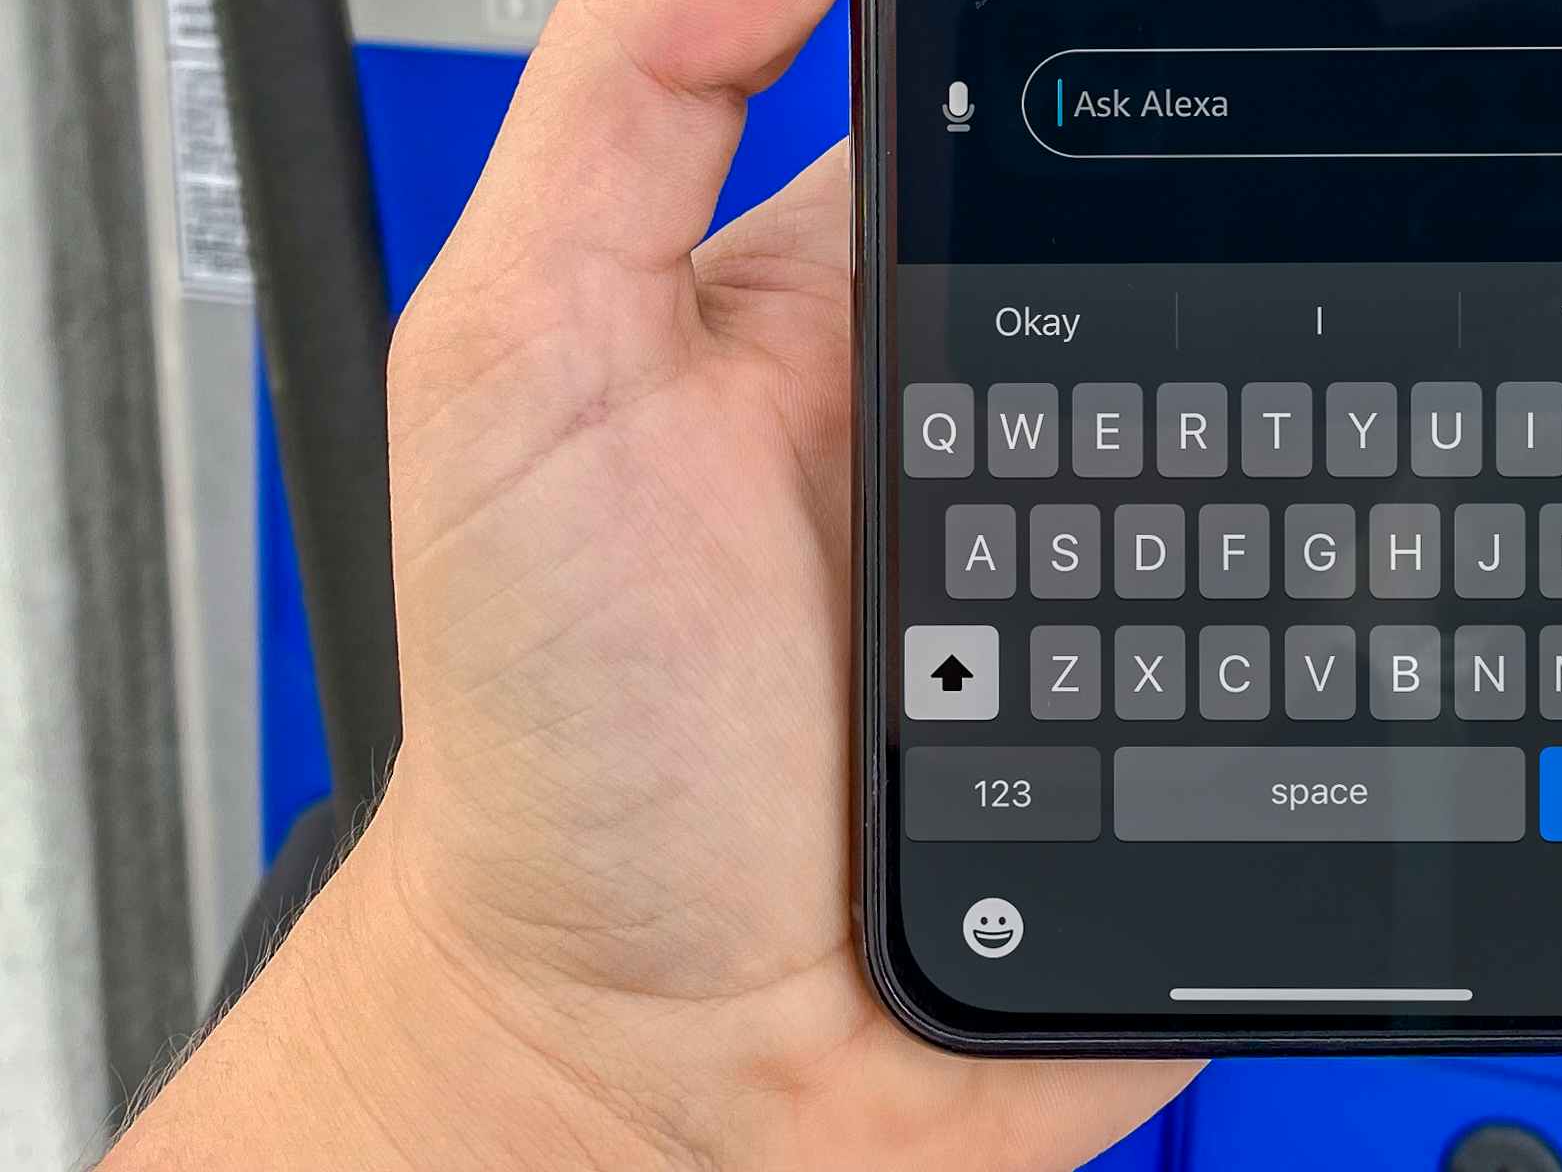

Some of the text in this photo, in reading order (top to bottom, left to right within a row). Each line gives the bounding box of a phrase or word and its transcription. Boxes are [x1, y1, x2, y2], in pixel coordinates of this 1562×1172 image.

[1073, 88, 1228, 118] Ask Alexa
[995, 306, 1081, 343] Okay
[1317, 306, 1323, 336] I
[922, 413, 957, 454] Q
[999, 413, 1044, 450] W
[1096, 413, 1120, 450] E
[1180, 413, 1207, 449] R
[1262, 412, 1291, 449] T
[1348, 412, 1377, 449] Y
[1431, 412, 1462, 450] U
[1527, 412, 1534, 449] I
[965, 534, 996, 571] A
[1051, 534, 1079, 572] S
[1136, 534, 1166, 571] D
[1223, 534, 1246, 571] F
[1304, 533, 1336, 571] G
[1390, 534, 1421, 571] H
[1478, 534, 1500, 571] J
[1051, 655, 1079, 692] Z
[1134, 655, 1163, 692] X
[1219, 654, 1250, 693] C
[1304, 655, 1335, 692] V
[1393, 655, 1420, 692] B
[1474, 655, 1505, 692] N
[974, 780, 1032, 808] 123
[1270, 779, 1369, 811] space
